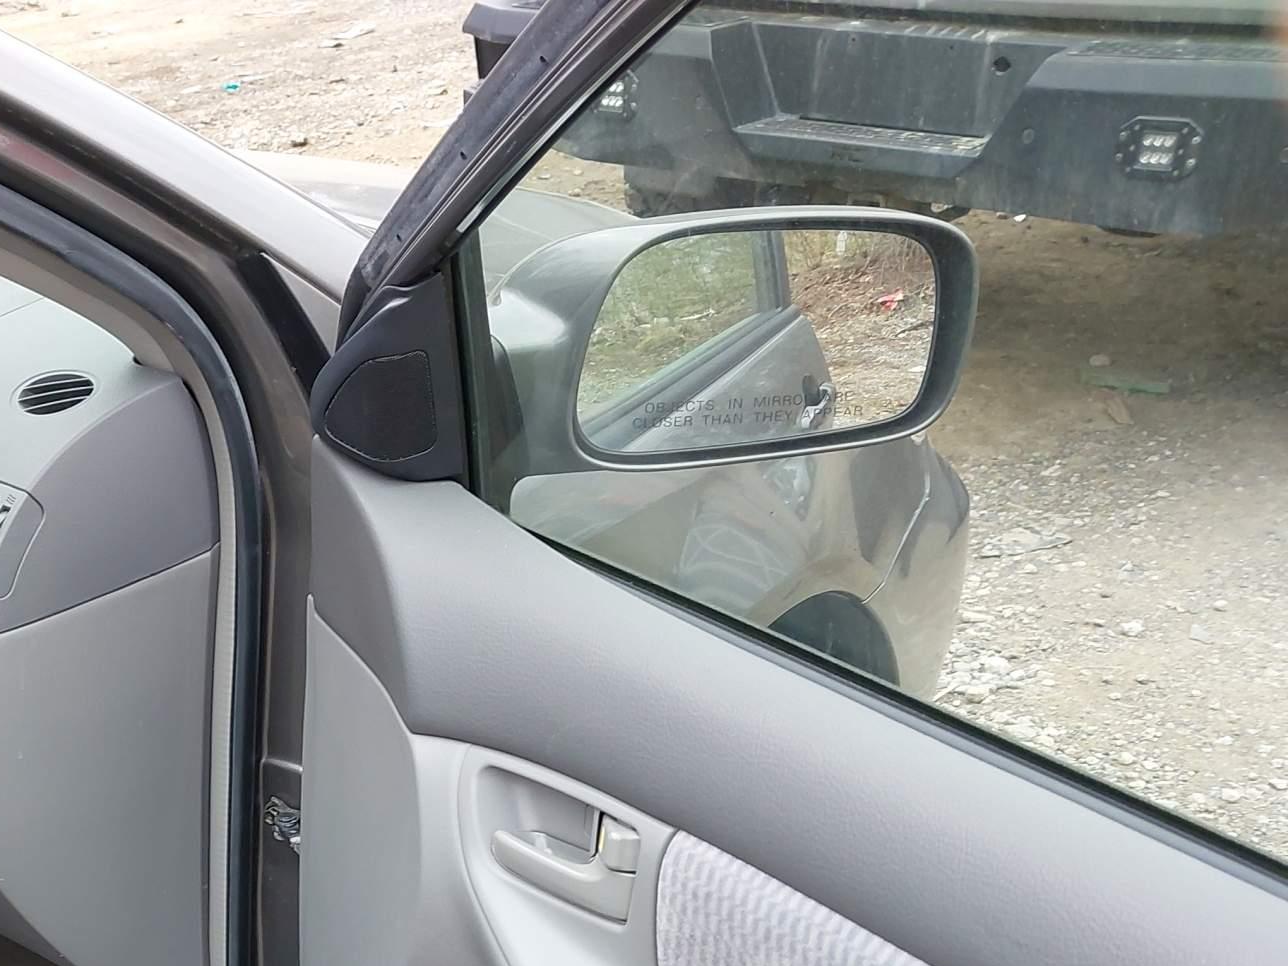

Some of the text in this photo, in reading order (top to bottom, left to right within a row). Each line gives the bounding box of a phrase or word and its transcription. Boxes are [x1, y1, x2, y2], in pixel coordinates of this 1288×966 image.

[644, 399, 715, 414] OBECTS
[728, 398, 743, 410] IN
[753, 393, 805, 408] MIRRO
[703, 413, 743, 425] THAN
[754, 409, 793, 422] THEY
